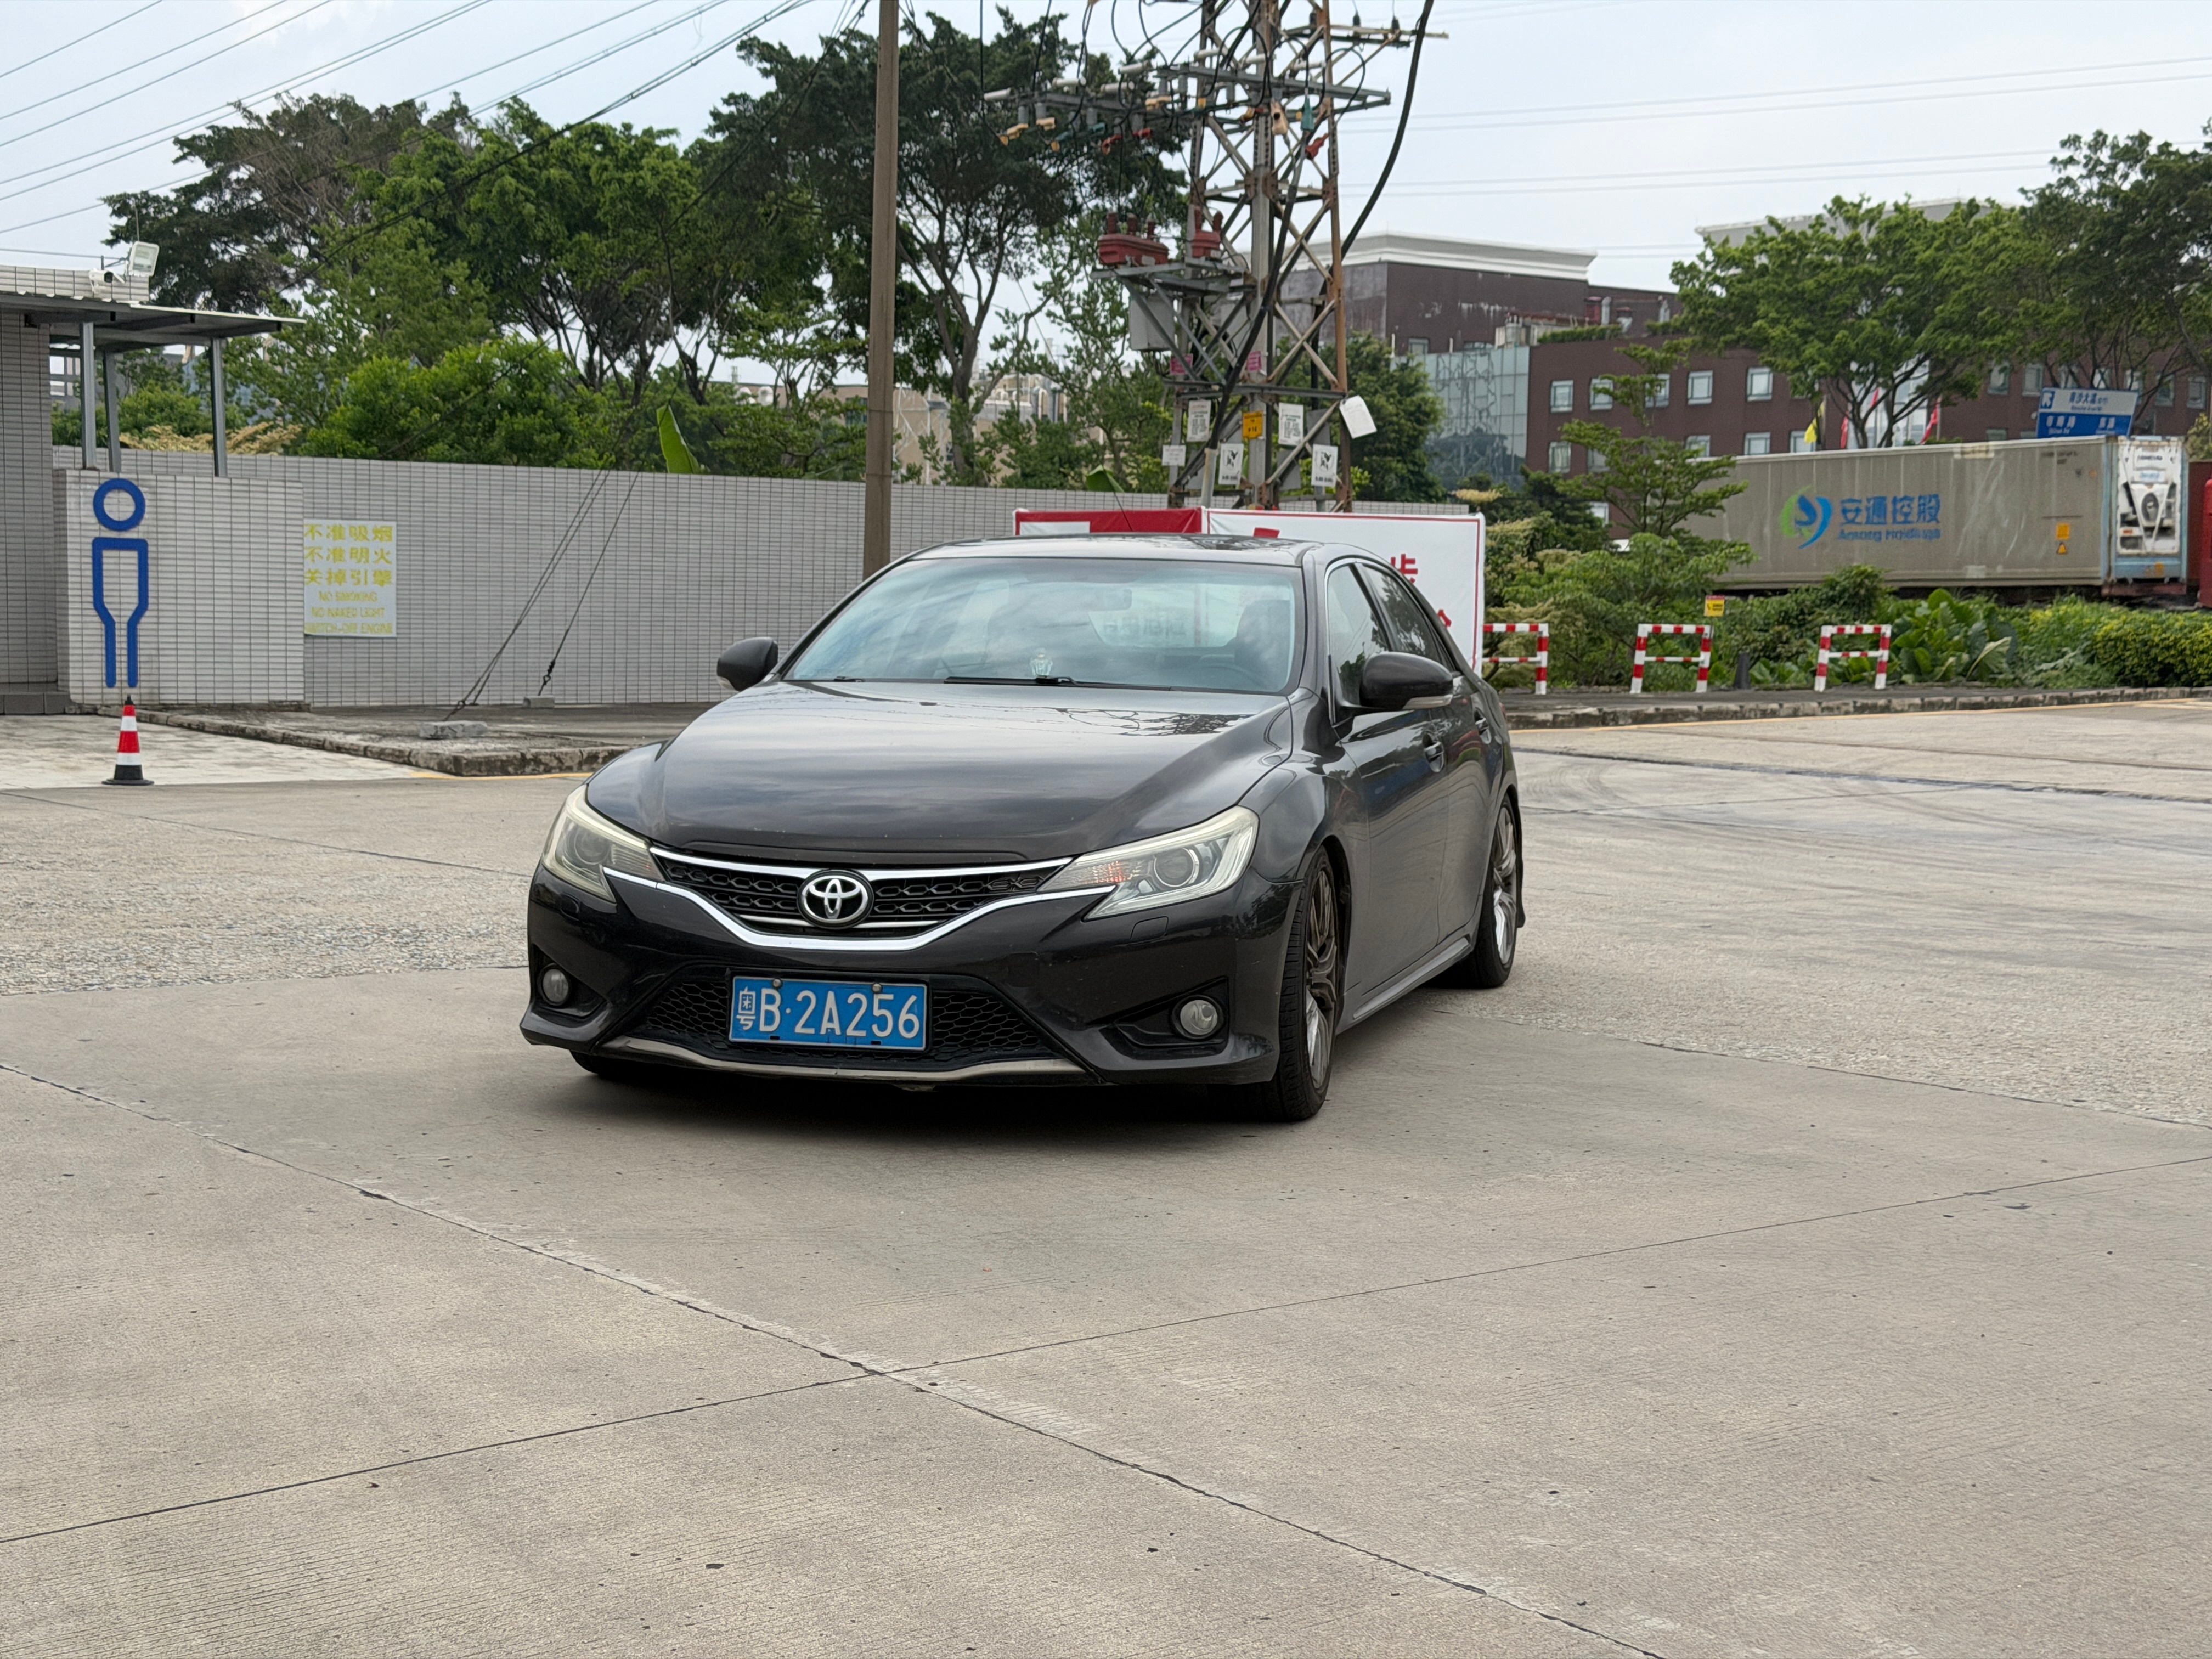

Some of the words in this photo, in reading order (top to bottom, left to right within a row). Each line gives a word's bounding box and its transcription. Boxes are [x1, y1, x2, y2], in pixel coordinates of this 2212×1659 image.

[1841, 493, 1940, 525] 安通控股
[304, 524, 393, 542] 不准吸烟
[304, 546, 392, 565] 不准明火
[304, 568, 393, 587] 关掉引擎
[319, 591, 332, 602] NO
[311, 607, 325, 618] NO
